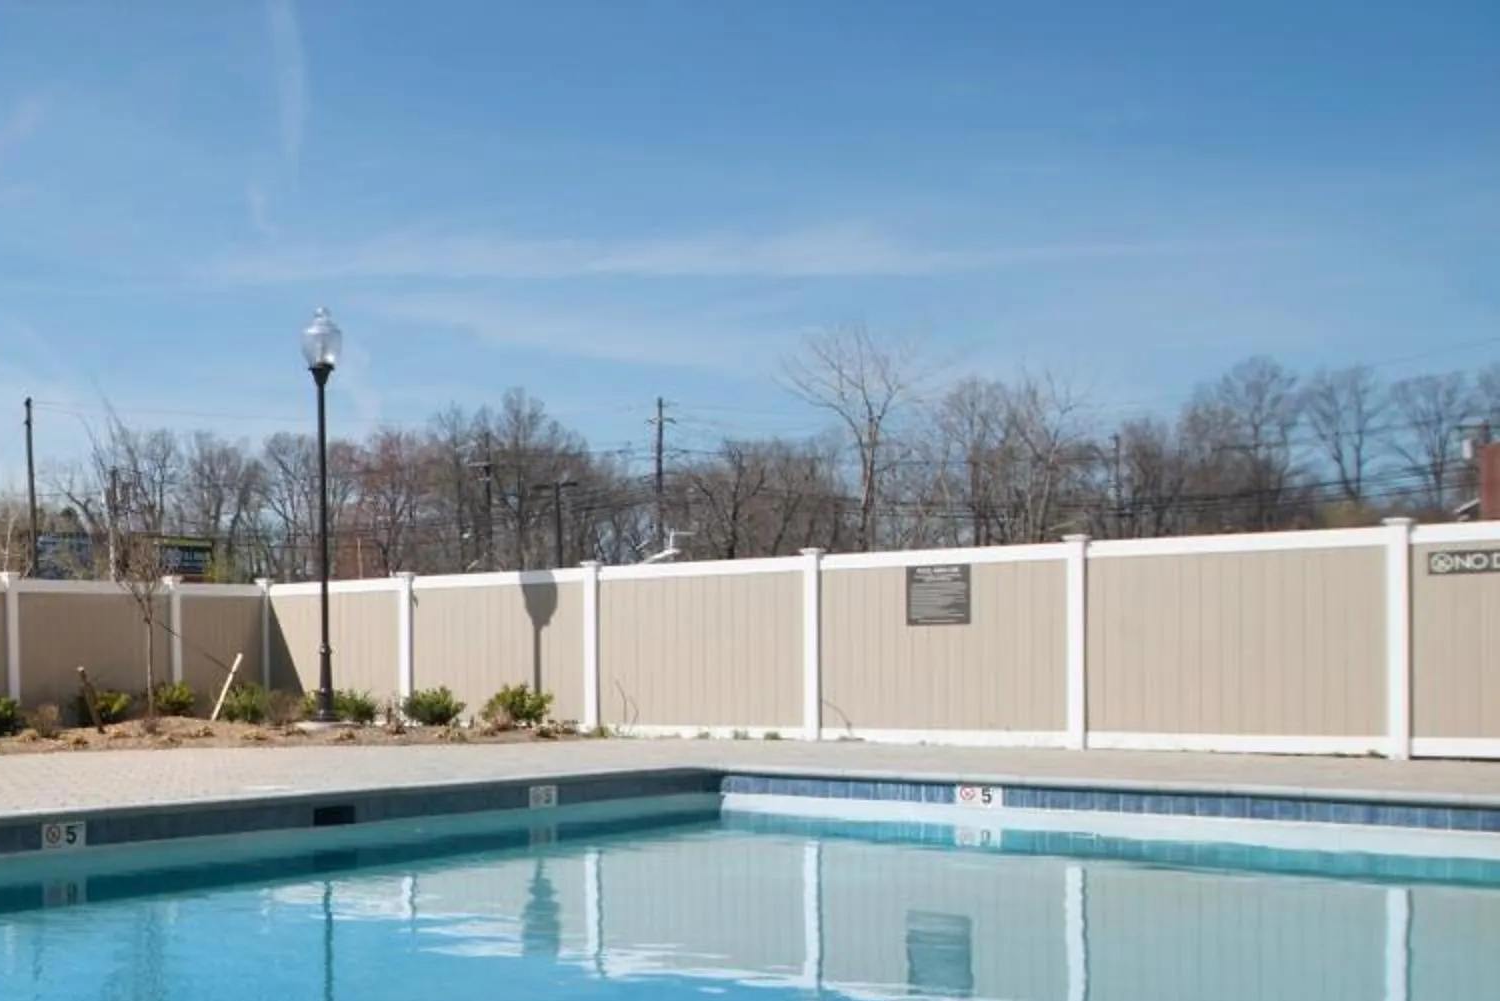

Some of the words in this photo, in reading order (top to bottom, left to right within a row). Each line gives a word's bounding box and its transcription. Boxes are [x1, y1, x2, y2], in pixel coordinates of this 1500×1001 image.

[1454, 553, 1488, 570] NO
[981, 787, 992, 804] 5
[65, 825, 77, 845] 5
